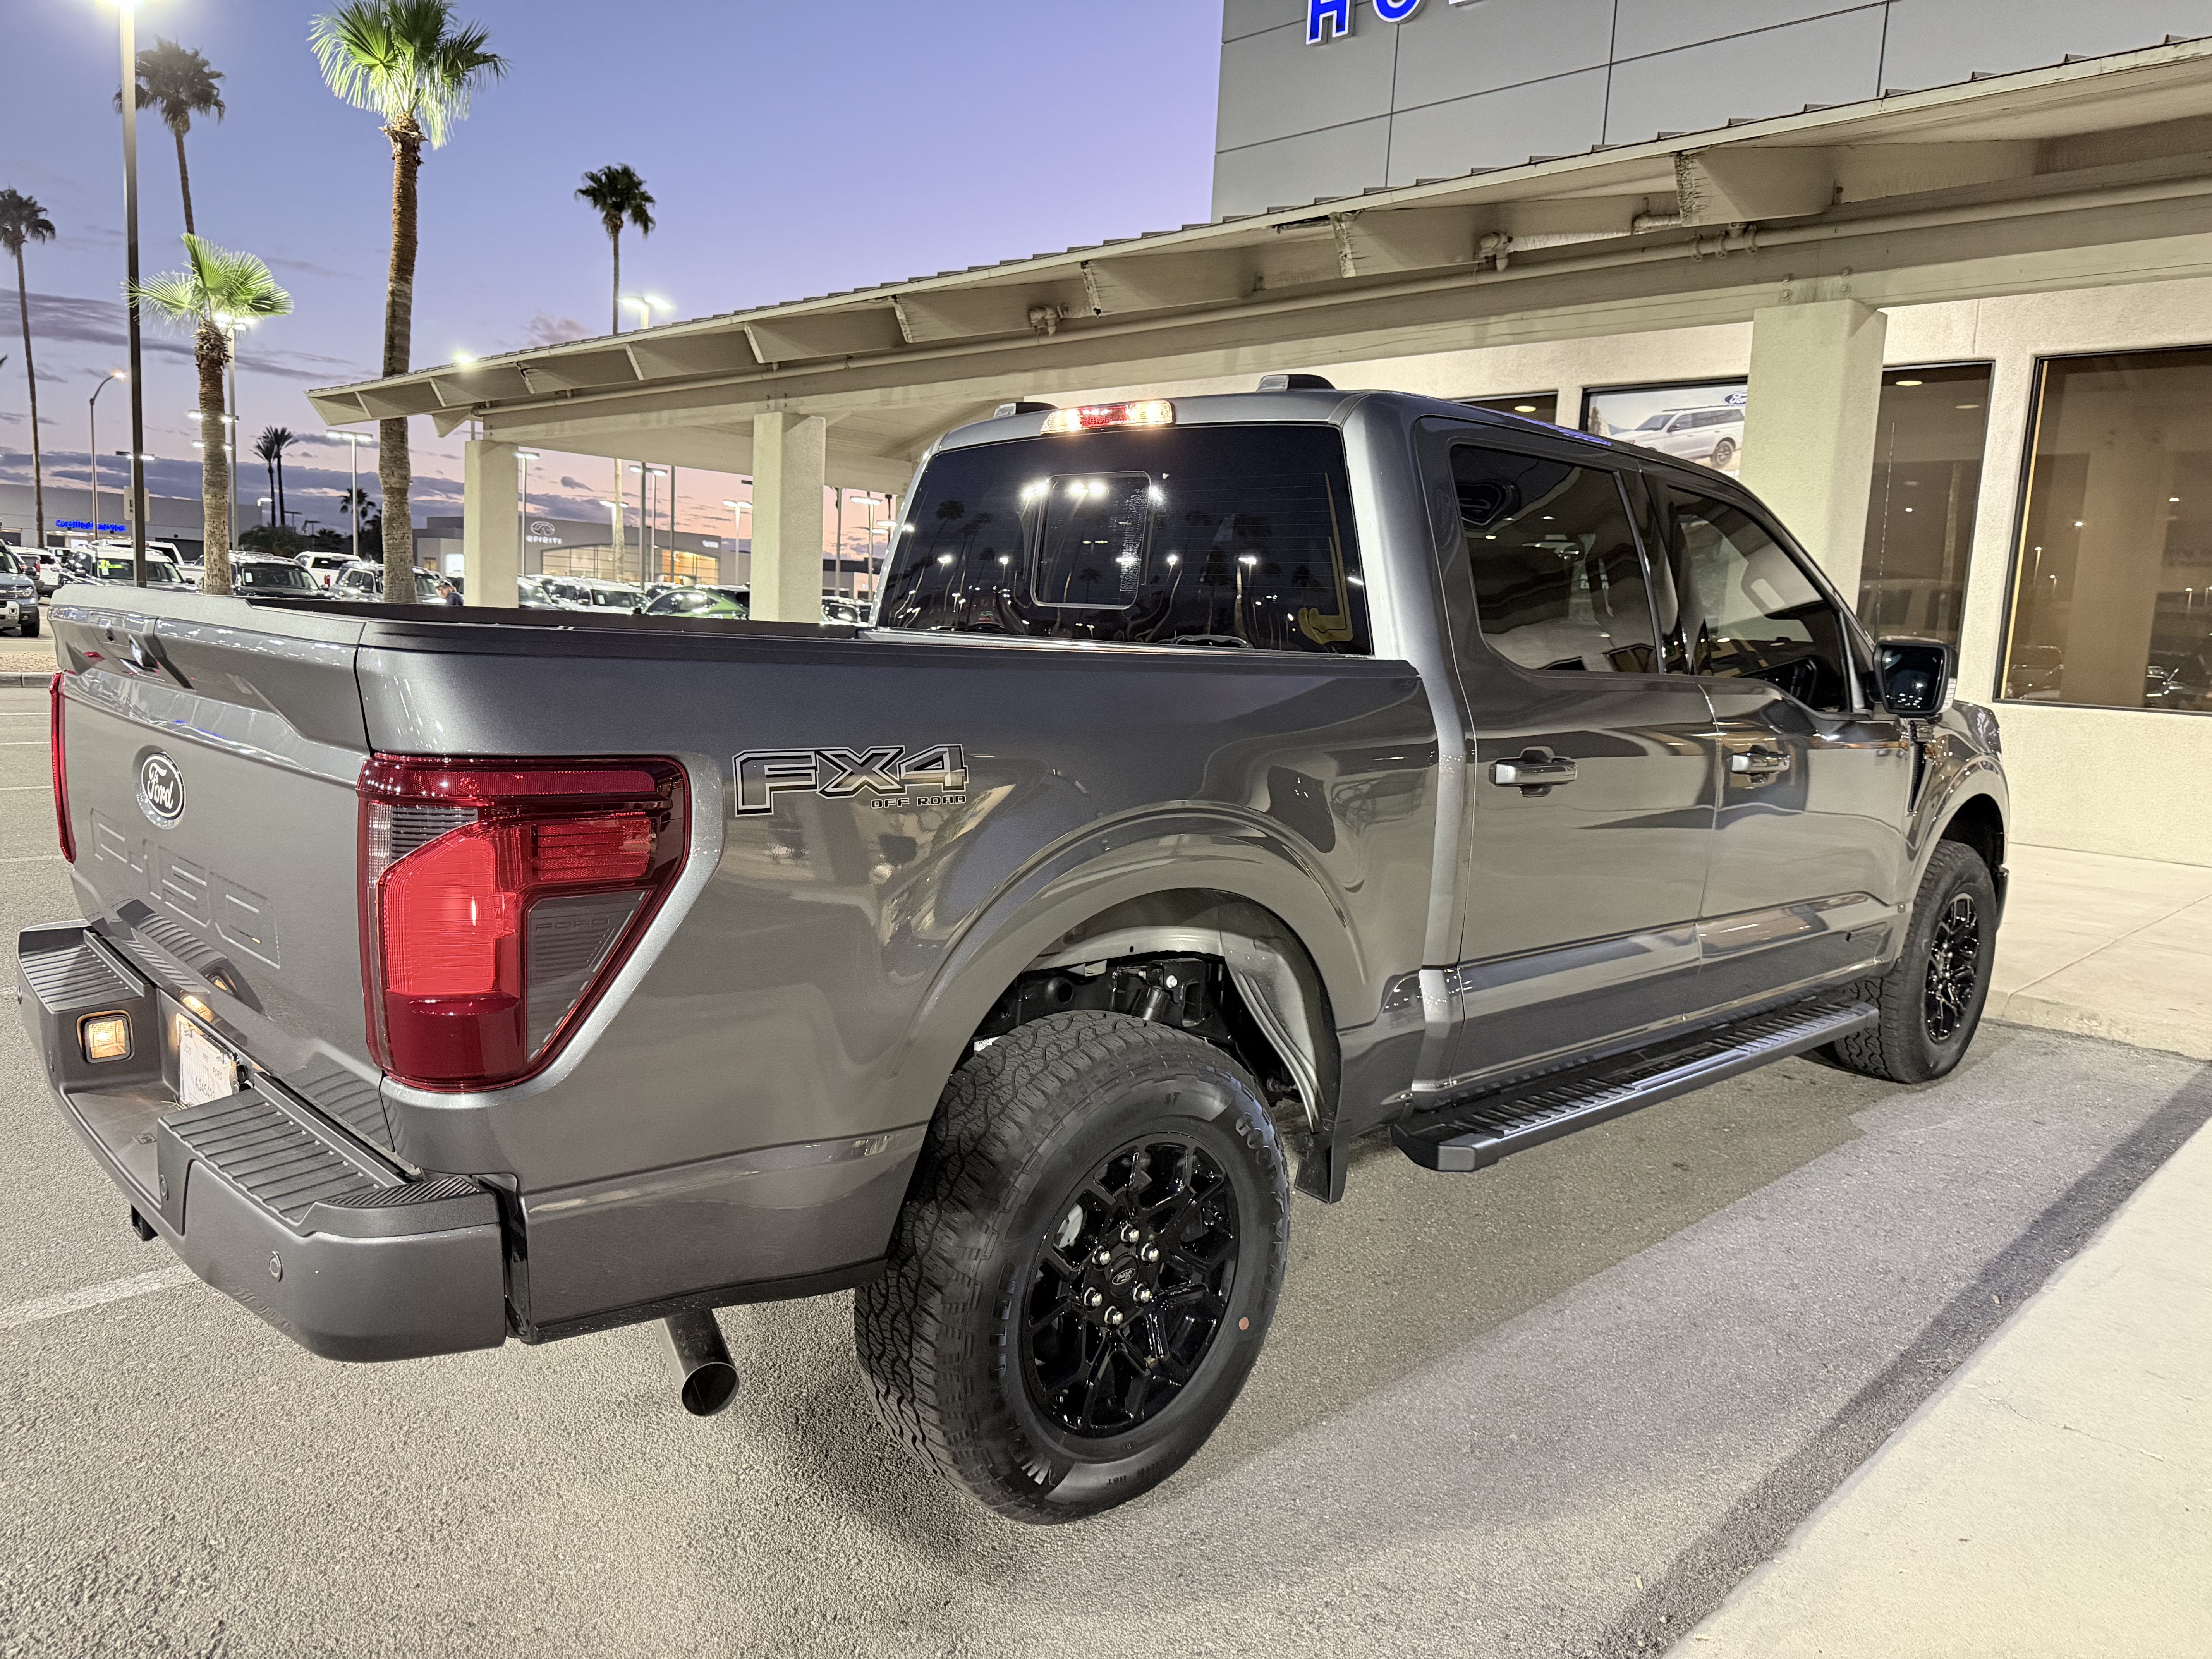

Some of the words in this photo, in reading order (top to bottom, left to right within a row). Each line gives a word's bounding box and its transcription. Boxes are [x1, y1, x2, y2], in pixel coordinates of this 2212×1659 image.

[525, 535, 562, 545] NFINITI
[147, 763, 174, 809] Ford
[732, 744, 969, 816] FX4
[871, 797, 910, 809] OFF
[917, 795, 967, 806] ROAD
